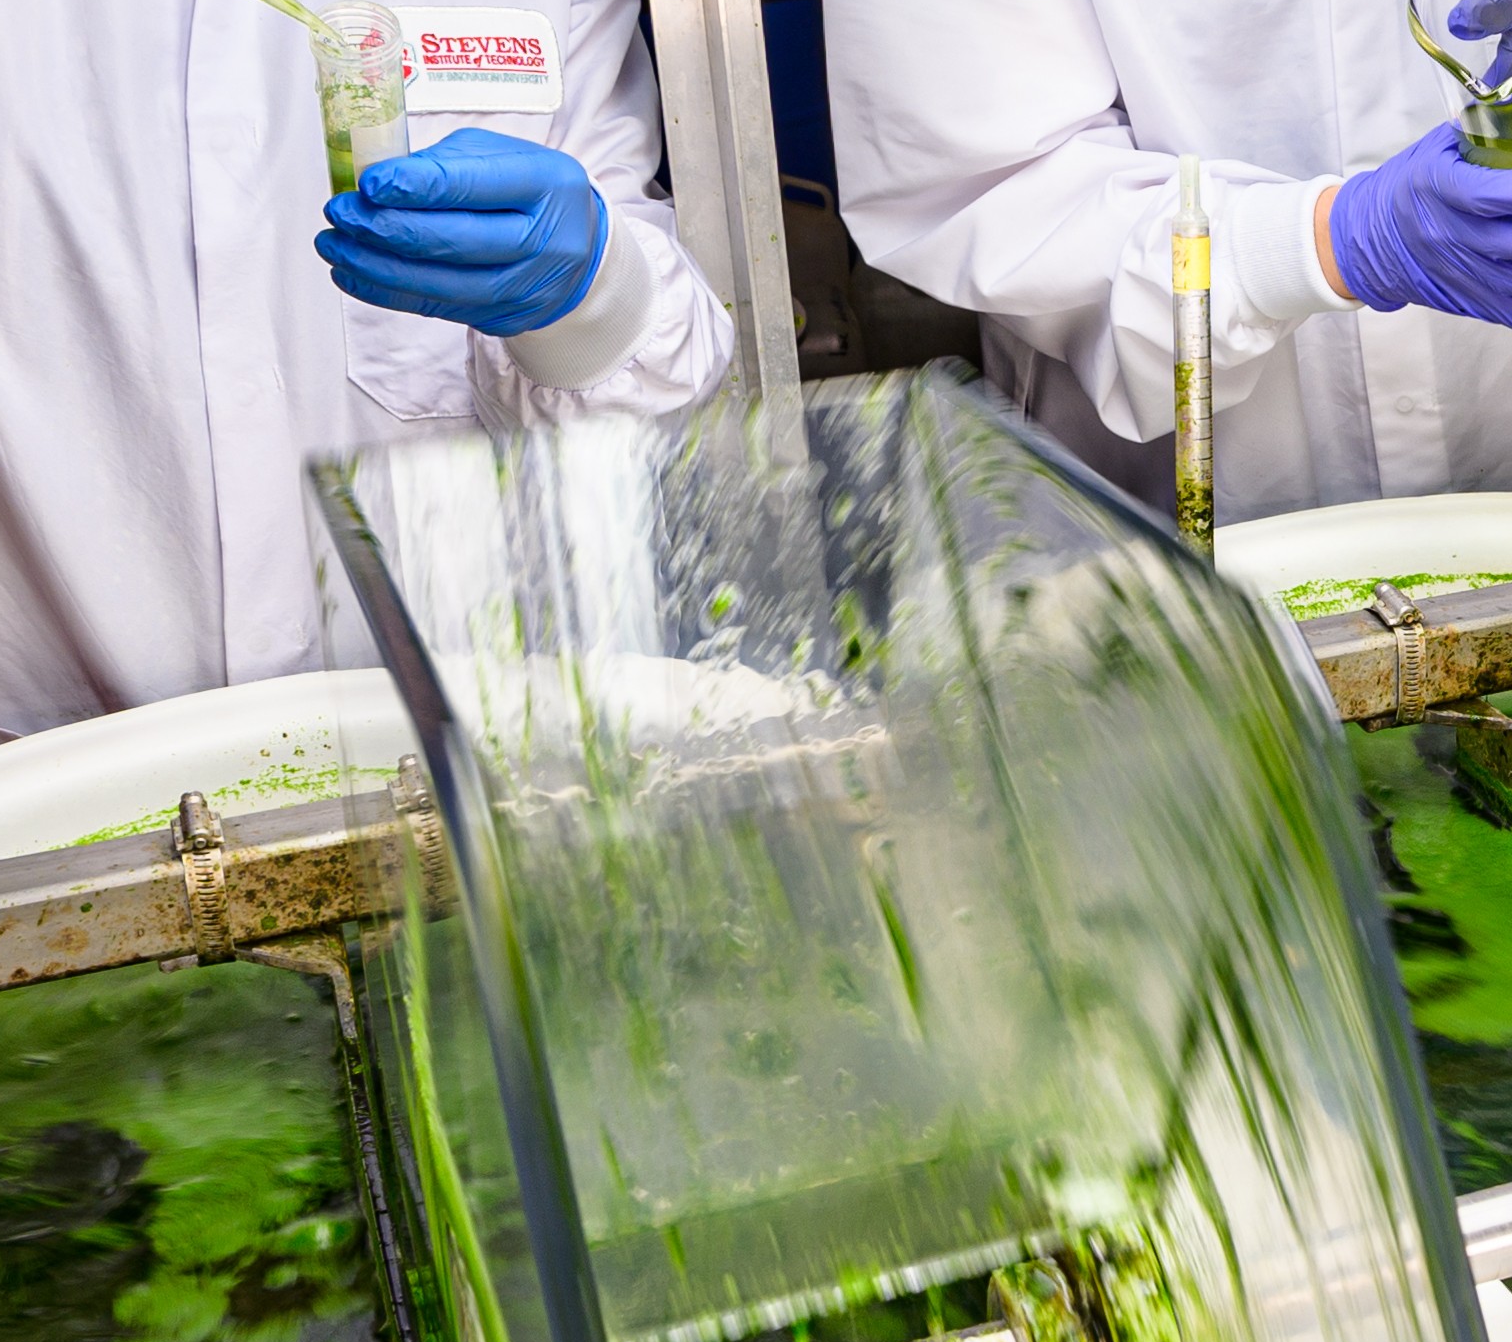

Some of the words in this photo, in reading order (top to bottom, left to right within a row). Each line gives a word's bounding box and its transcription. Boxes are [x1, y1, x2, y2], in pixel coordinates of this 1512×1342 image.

[421, 33, 542, 55] STEVENS
[422, 55, 471, 65] INSTITUTE
[473, 55, 483, 68] of
[486, 55, 545, 67] TECHNOLOGY
[427, 72, 446, 82] THE
[500, 73, 549, 85] UNIVERSITY
